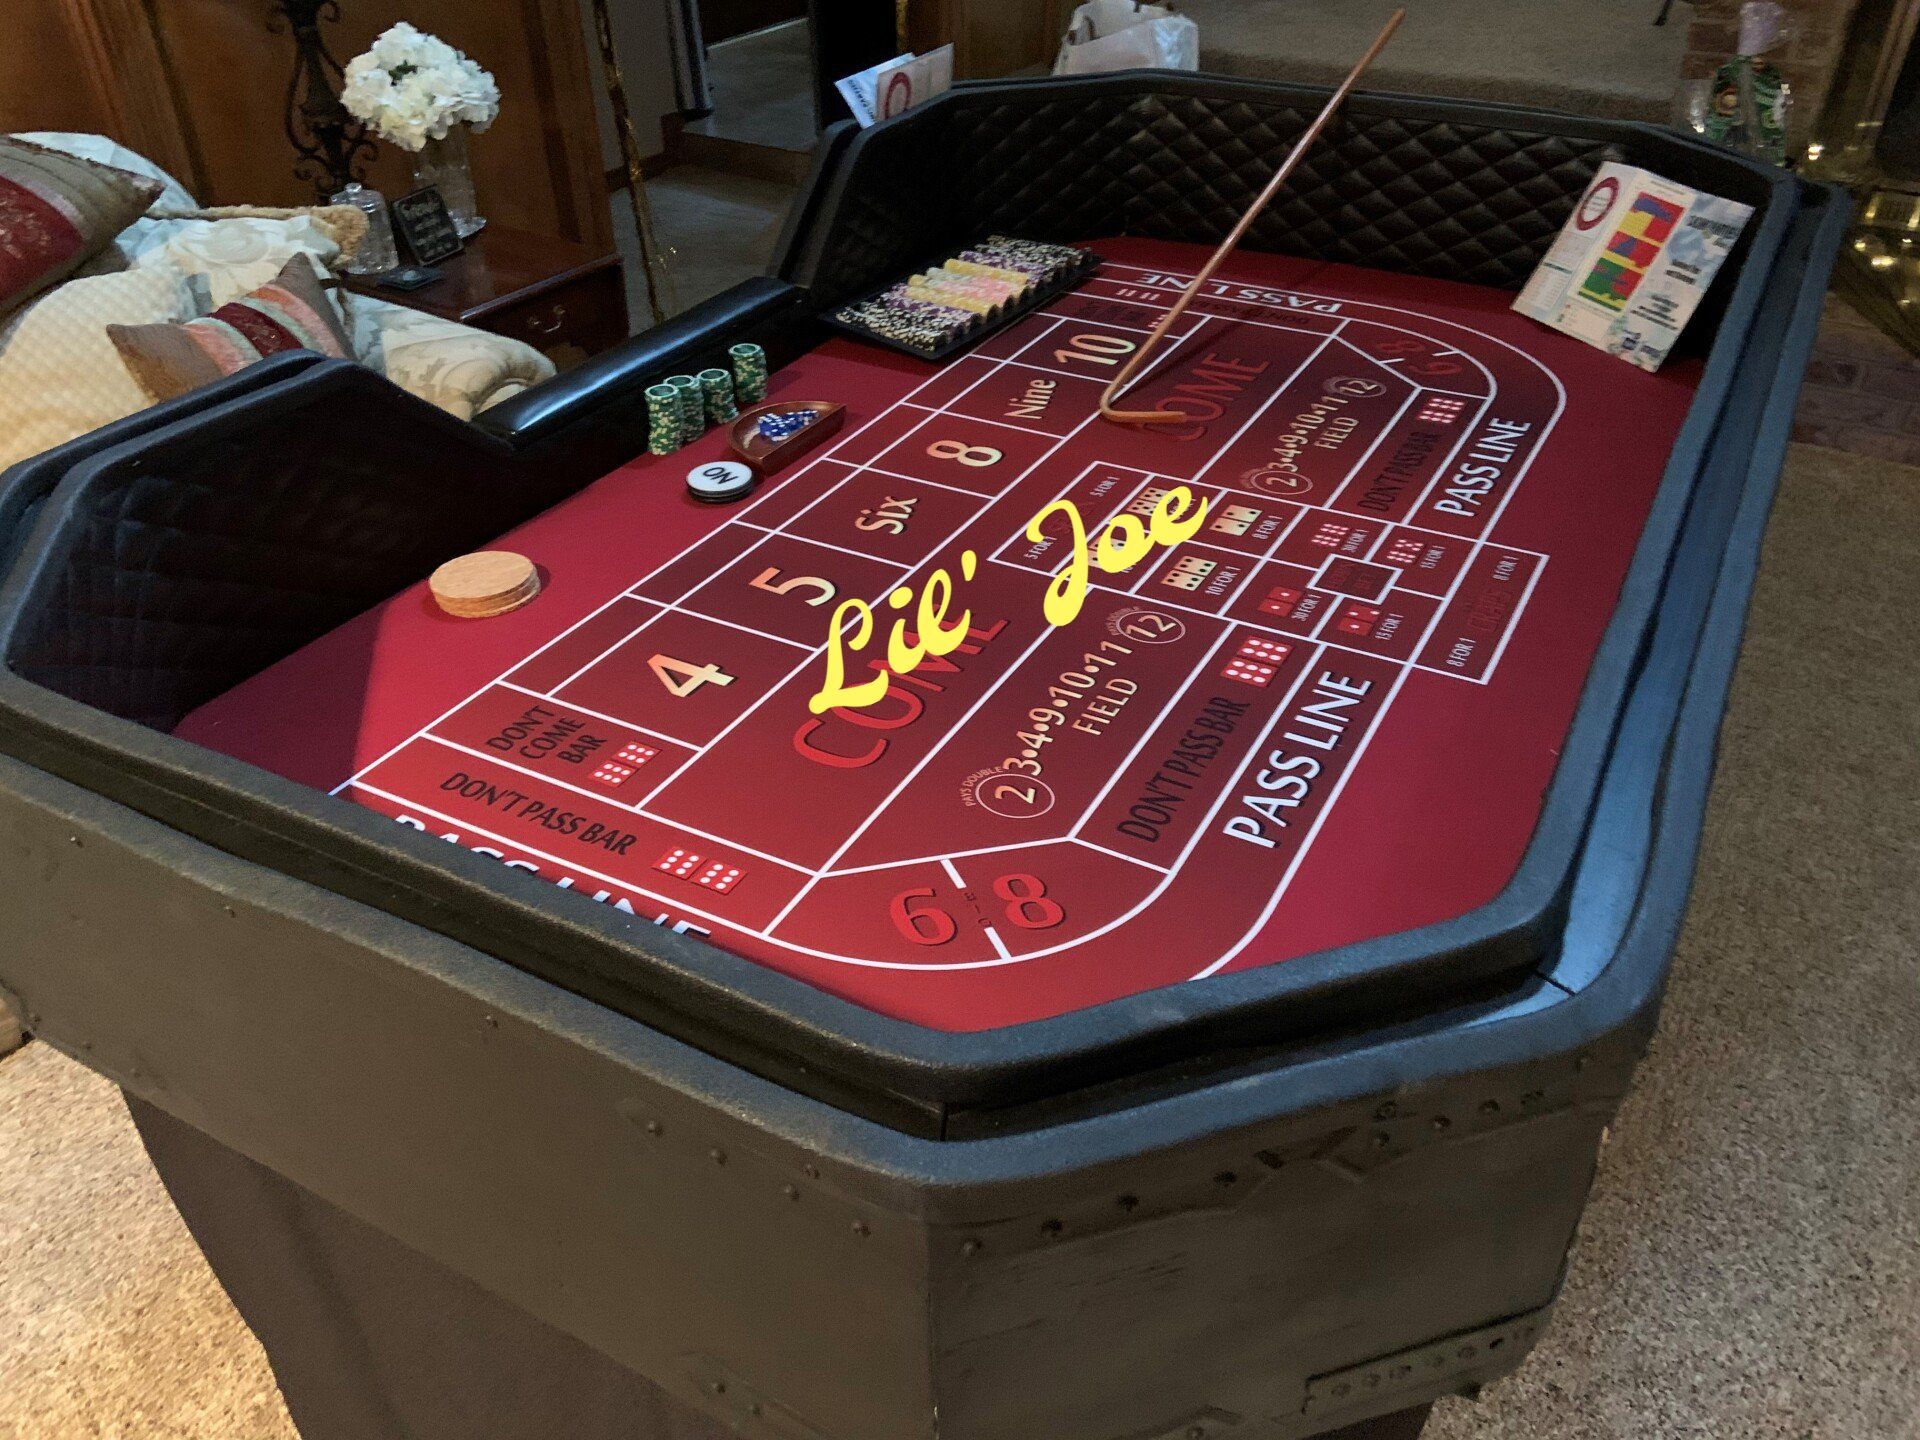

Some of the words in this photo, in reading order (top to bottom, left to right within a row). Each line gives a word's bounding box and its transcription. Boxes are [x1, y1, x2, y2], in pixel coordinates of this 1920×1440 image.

[1236, 288, 1343, 314] PASS
[1054, 334, 1137, 366] 10
[1003, 379, 1057, 420] Nine
[1338, 379, 1379, 395] 12
[926, 439, 1004, 467] 8
[1313, 416, 1360, 450] FIELD
[702, 466, 738, 486] ON
[1265, 476, 1298, 488] 2
[1433, 462, 1501, 517] PASS
[1468, 417, 1532, 463] LINE
[855, 496, 919, 535] Six
[749, 566, 837, 607] 5
[1125, 613, 1177, 639] 12
[646, 653, 735, 698] 4
[1071, 677, 1139, 736] FIELD
[519, 717, 586, 760] COME
[556, 734, 608, 764] BAR
[1163, 729, 1224, 778] PASS
[1194, 696, 1250, 734] BAR
[1222, 748, 1322, 849] PASS
[1282, 670, 1372, 751] LINE
[994, 785, 1036, 805] 2
[516, 800, 587, 836] PASS
[577, 822, 638, 856] BAR
[889, 887, 956, 946] 6
[992, 873, 1065, 929] 8
